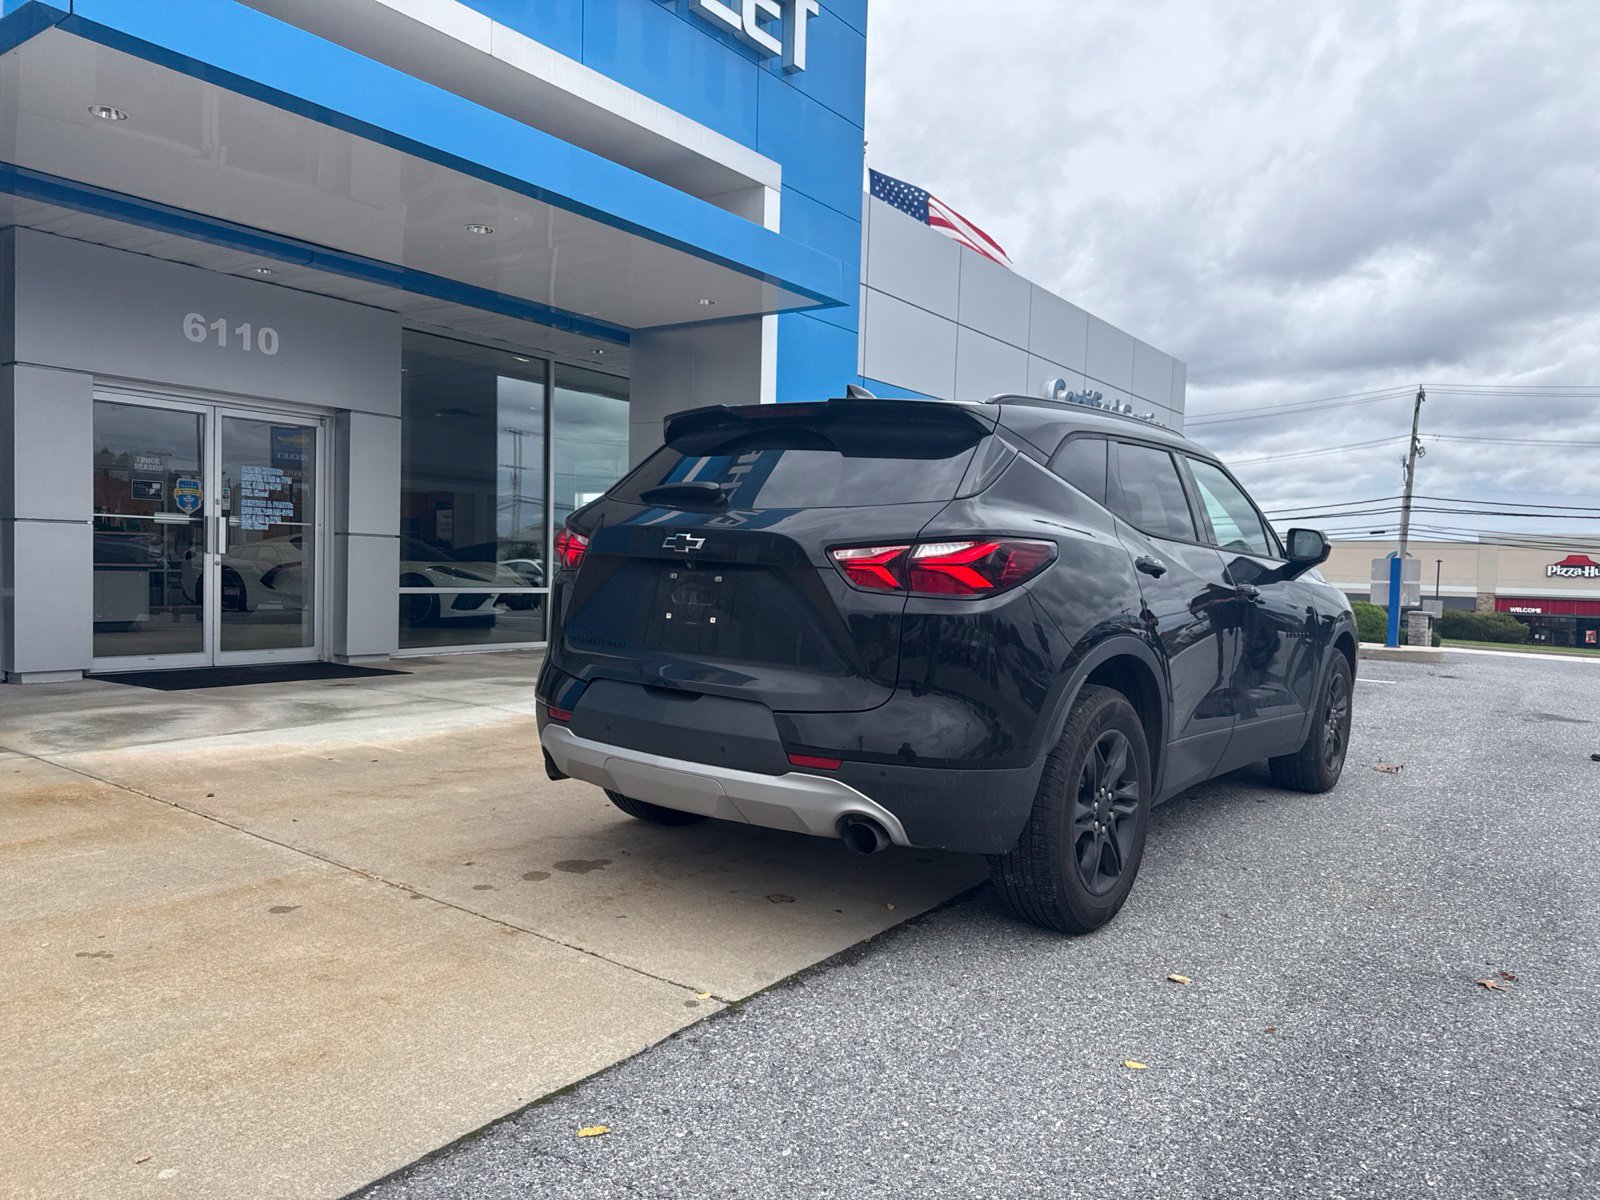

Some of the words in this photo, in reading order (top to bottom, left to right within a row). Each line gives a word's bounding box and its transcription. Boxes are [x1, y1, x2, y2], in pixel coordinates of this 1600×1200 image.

[183, 312, 279, 355] 6110
[1547, 564, 1582, 577] Pizza
[1582, 565, 1600, 577] Hu
[1509, 606, 1542, 614] WELCOME
